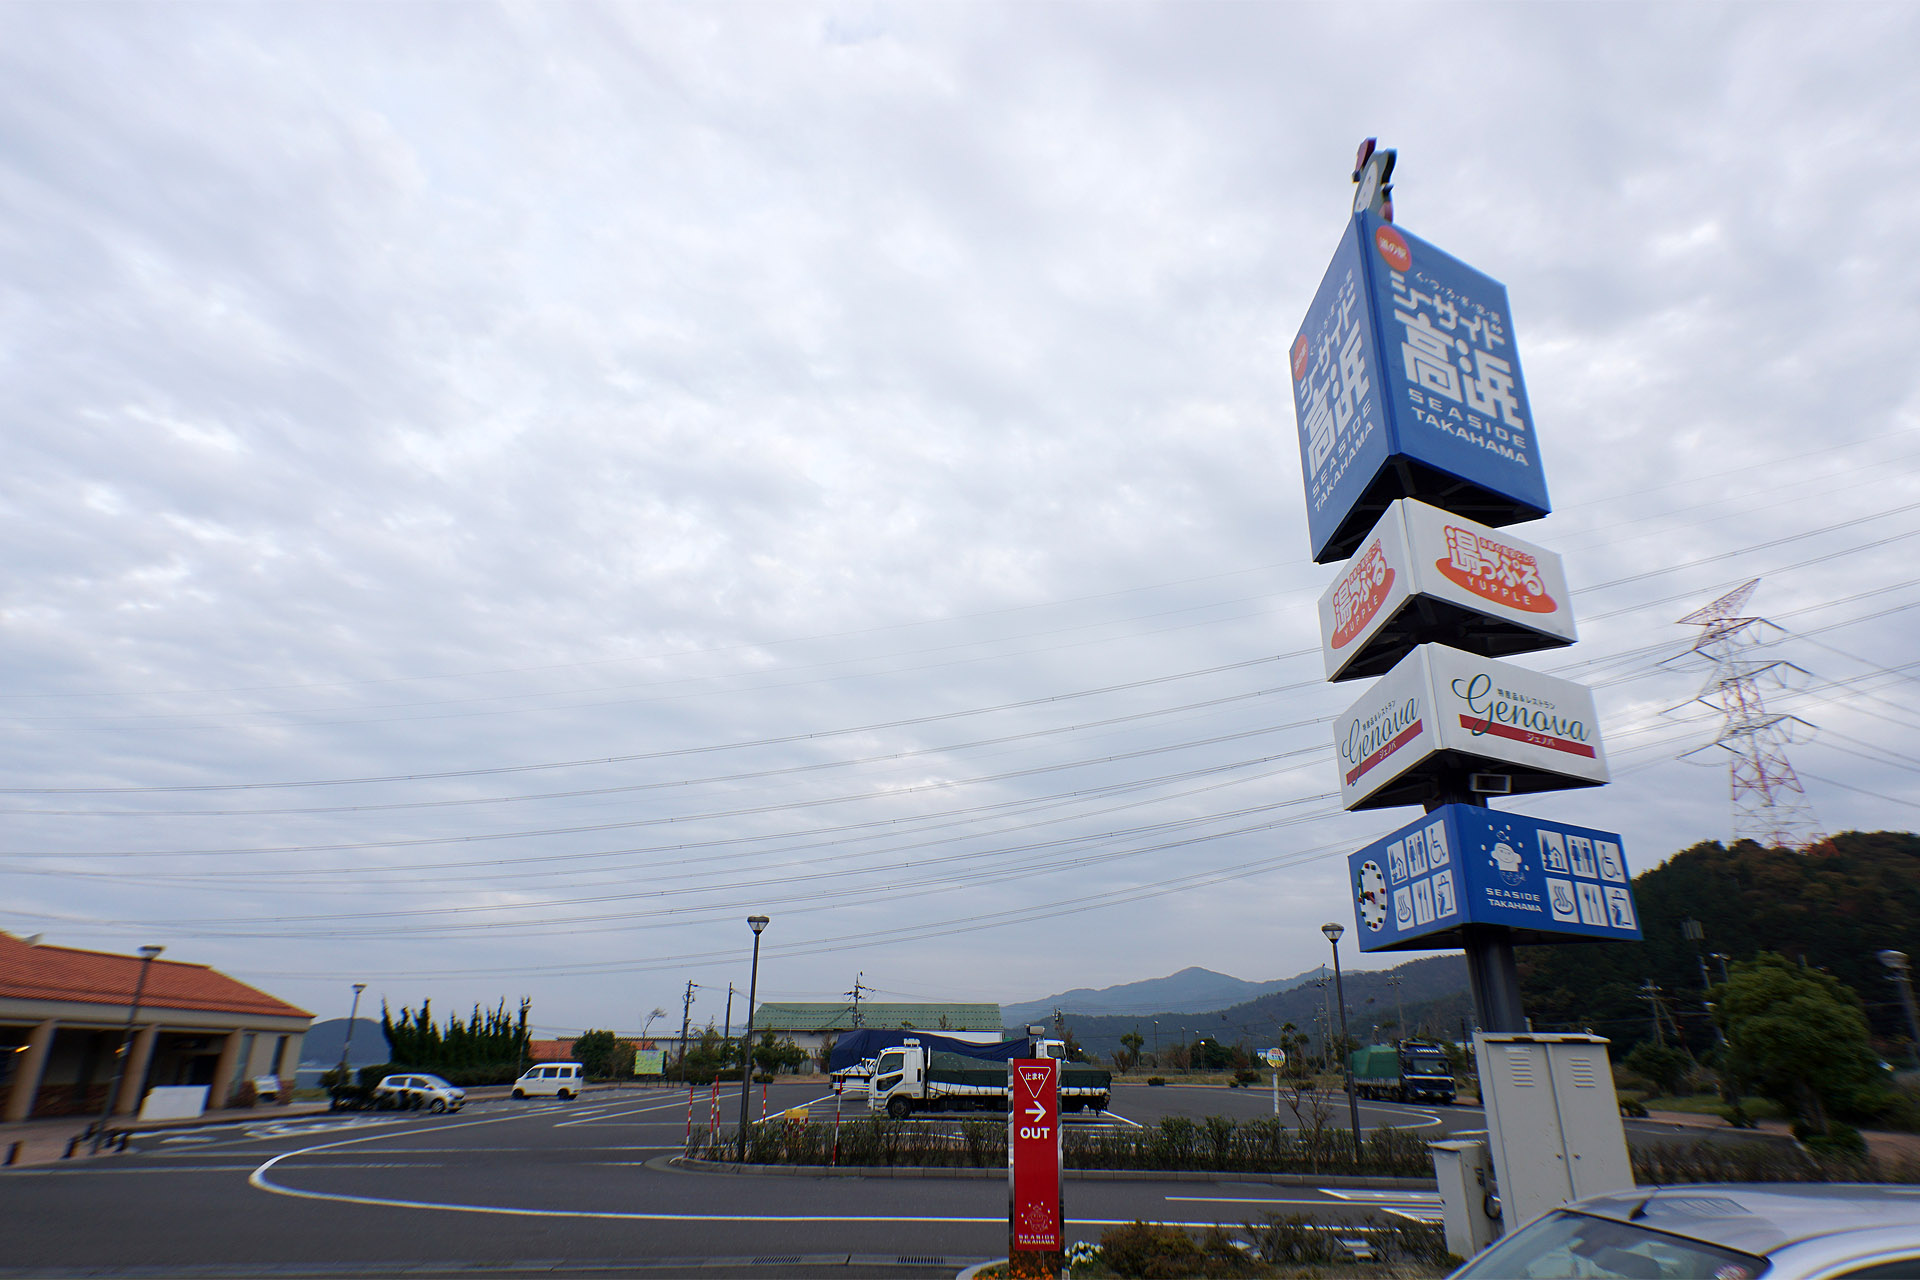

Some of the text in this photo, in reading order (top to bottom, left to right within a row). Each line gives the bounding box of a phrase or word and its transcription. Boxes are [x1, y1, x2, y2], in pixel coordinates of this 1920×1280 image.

[1389, 270, 1505, 350] シーサイド
[1299, 281, 1357, 411] シーサイド
[1394, 308, 1525, 431] 高浜
[1303, 318, 1370, 481] 高浜
[1408, 387, 1527, 449] SEASIDE
[1311, 401, 1371, 499] SEASIDE
[1314, 422, 1374, 512] TAKAHAMA
[1411, 407, 1529, 466] TAKAHAMA
[1333, 549, 1387, 634] 湯っぷる
[1444, 525, 1544, 597] 湯っぷる
[1466, 576, 1531, 605] YUPPLE
[1343, 594, 1379, 638] YUPPLE
[1341, 697, 1420, 787] Genova
[1450, 673, 1591, 741] Genova
[1485, 887, 1541, 902] SEASIDE
[1487, 898, 1543, 913] TAKAHAMA
[1025, 1072, 1045, 1081] 止まれ
[1020, 1127, 1050, 1139] OUT
